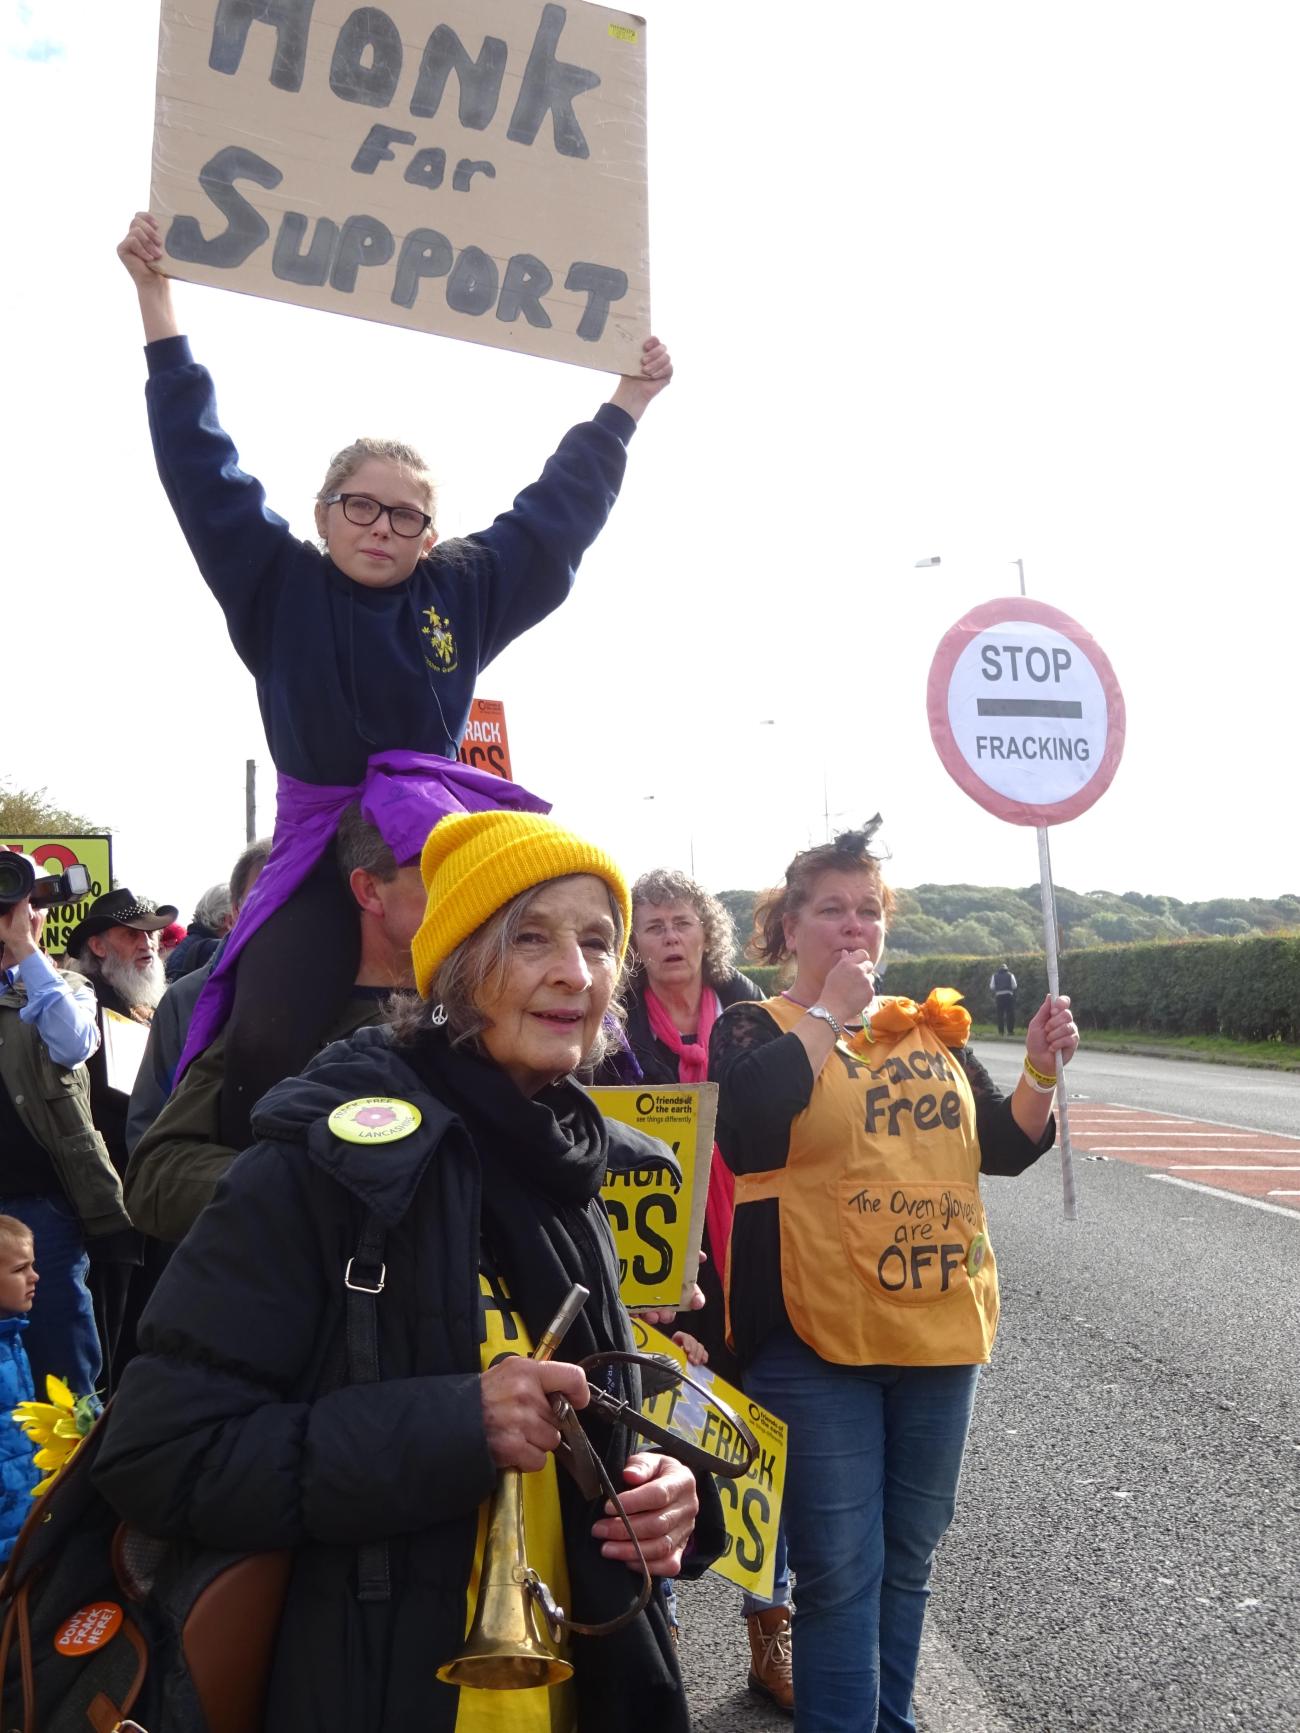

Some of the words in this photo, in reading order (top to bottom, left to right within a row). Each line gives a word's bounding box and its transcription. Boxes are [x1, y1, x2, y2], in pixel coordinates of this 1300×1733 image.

[165, 145, 628, 342] SUPPORT
[981, 645, 1072, 683] STOP
[466, 721, 501, 743] RACK
[976, 736, 1090, 761] FRACKING
[671, 1105, 692, 1113] earth
[864, 1085, 961, 1136] Free
[848, 1190, 881, 1214] The
[890, 1190, 935, 1219] Oven
[894, 1223, 934, 1244] are
[878, 1244, 965, 1292] OFF
[59, 1609, 87, 1645] DON'T
